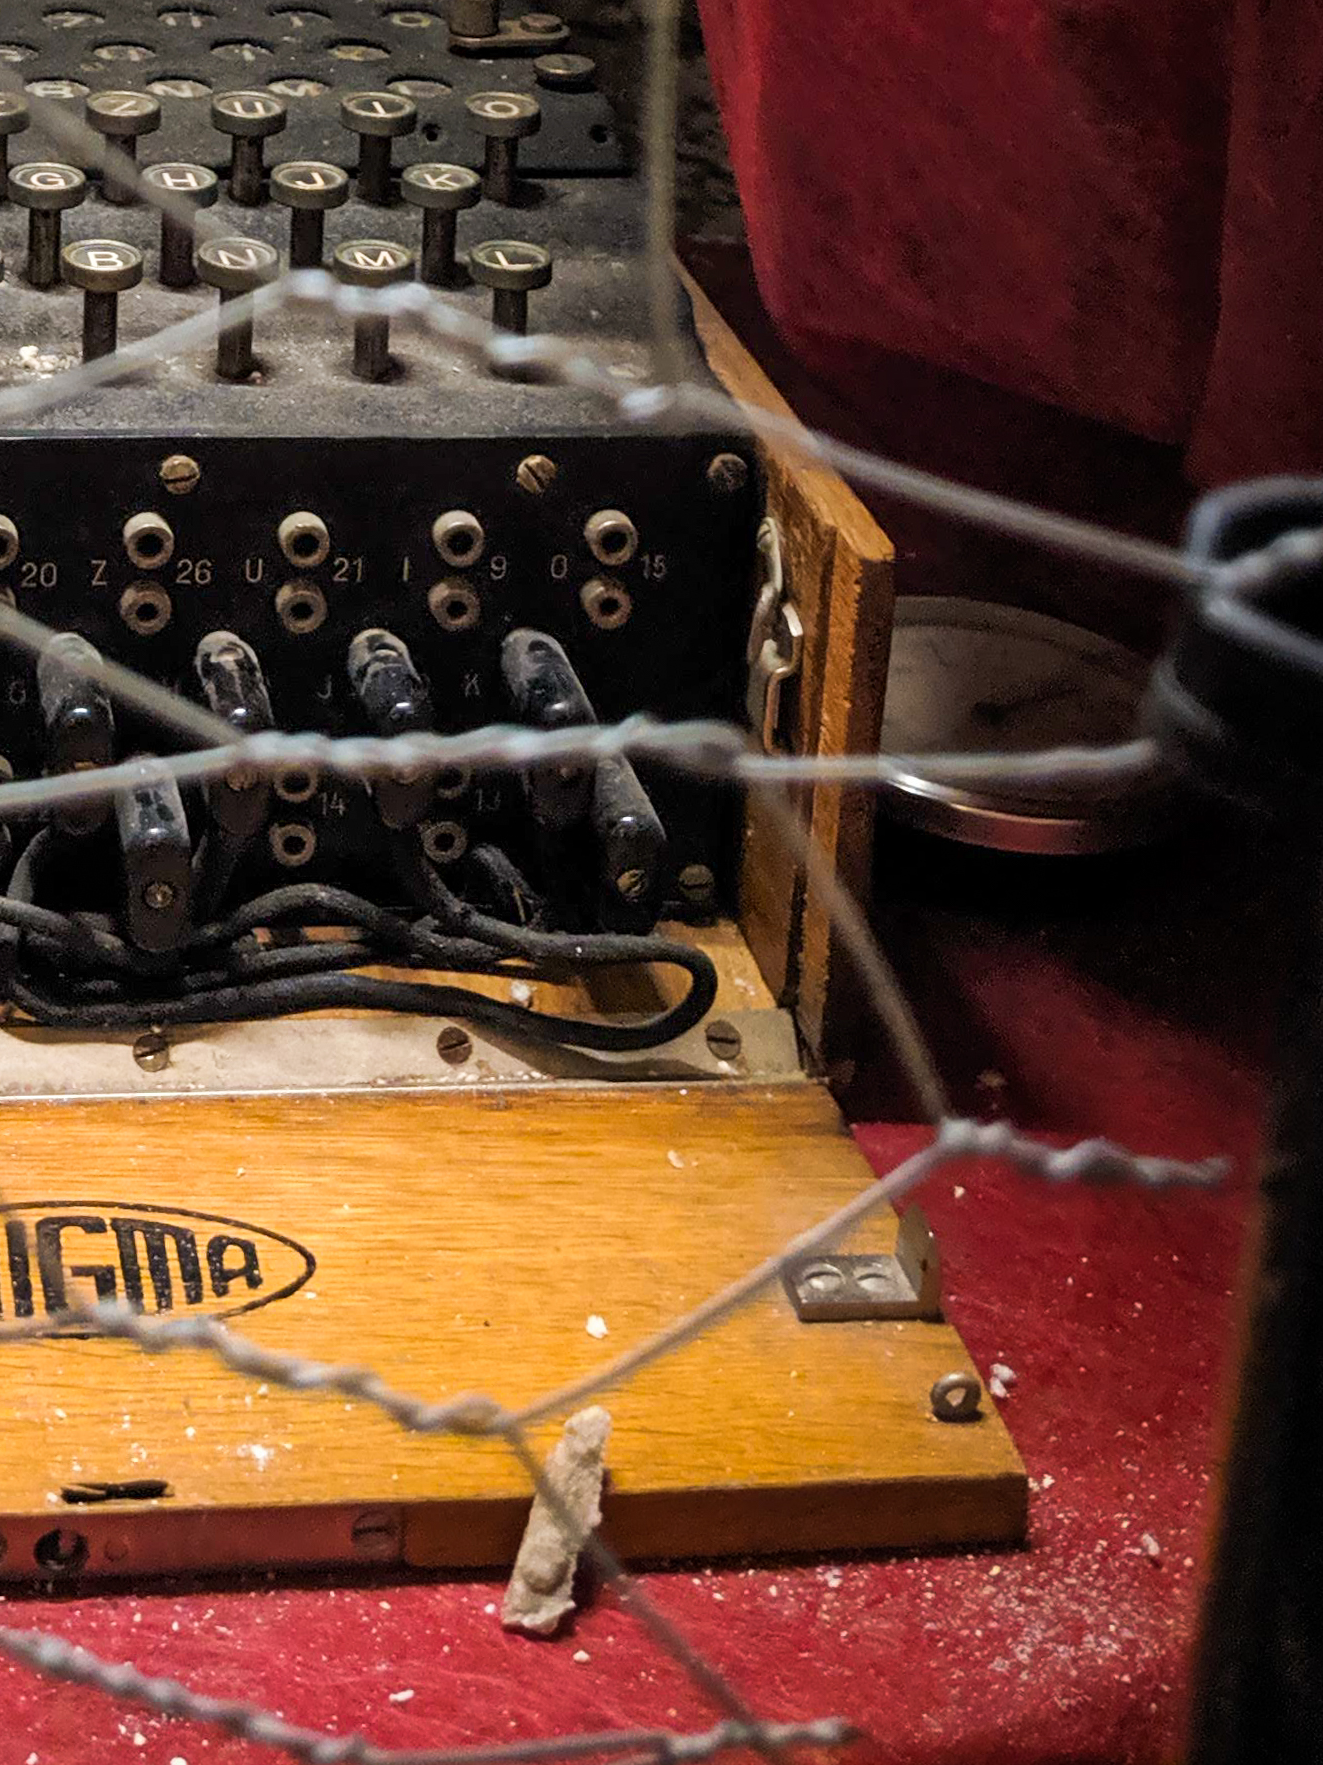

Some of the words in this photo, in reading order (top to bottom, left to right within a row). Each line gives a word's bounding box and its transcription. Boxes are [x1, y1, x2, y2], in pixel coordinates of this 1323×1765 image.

[110, 101, 138, 114] Z
[233, 101, 264, 116] U
[371, 101, 387, 116] I
[484, 101, 519, 117] O
[29, 171, 67, 187] G
[161, 172, 198, 189] H
[294, 171, 325, 189] J
[423, 173, 456, 189] K
[86, 251, 124, 270] B
[217, 248, 258, 267] N
[352, 250, 397, 267] M
[495, 250, 534, 270] L
[21, 562, 58, 587] 20
[90, 559, 108, 586] Z
[176, 558, 213, 585] 26
[245, 557, 264, 583] U
[332, 557, 364, 583] 21
[490, 554, 508, 580] 9
[639, 554, 668, 580] 15
[316, 675, 333, 700] J
[321, 792, 346, 816] 14
